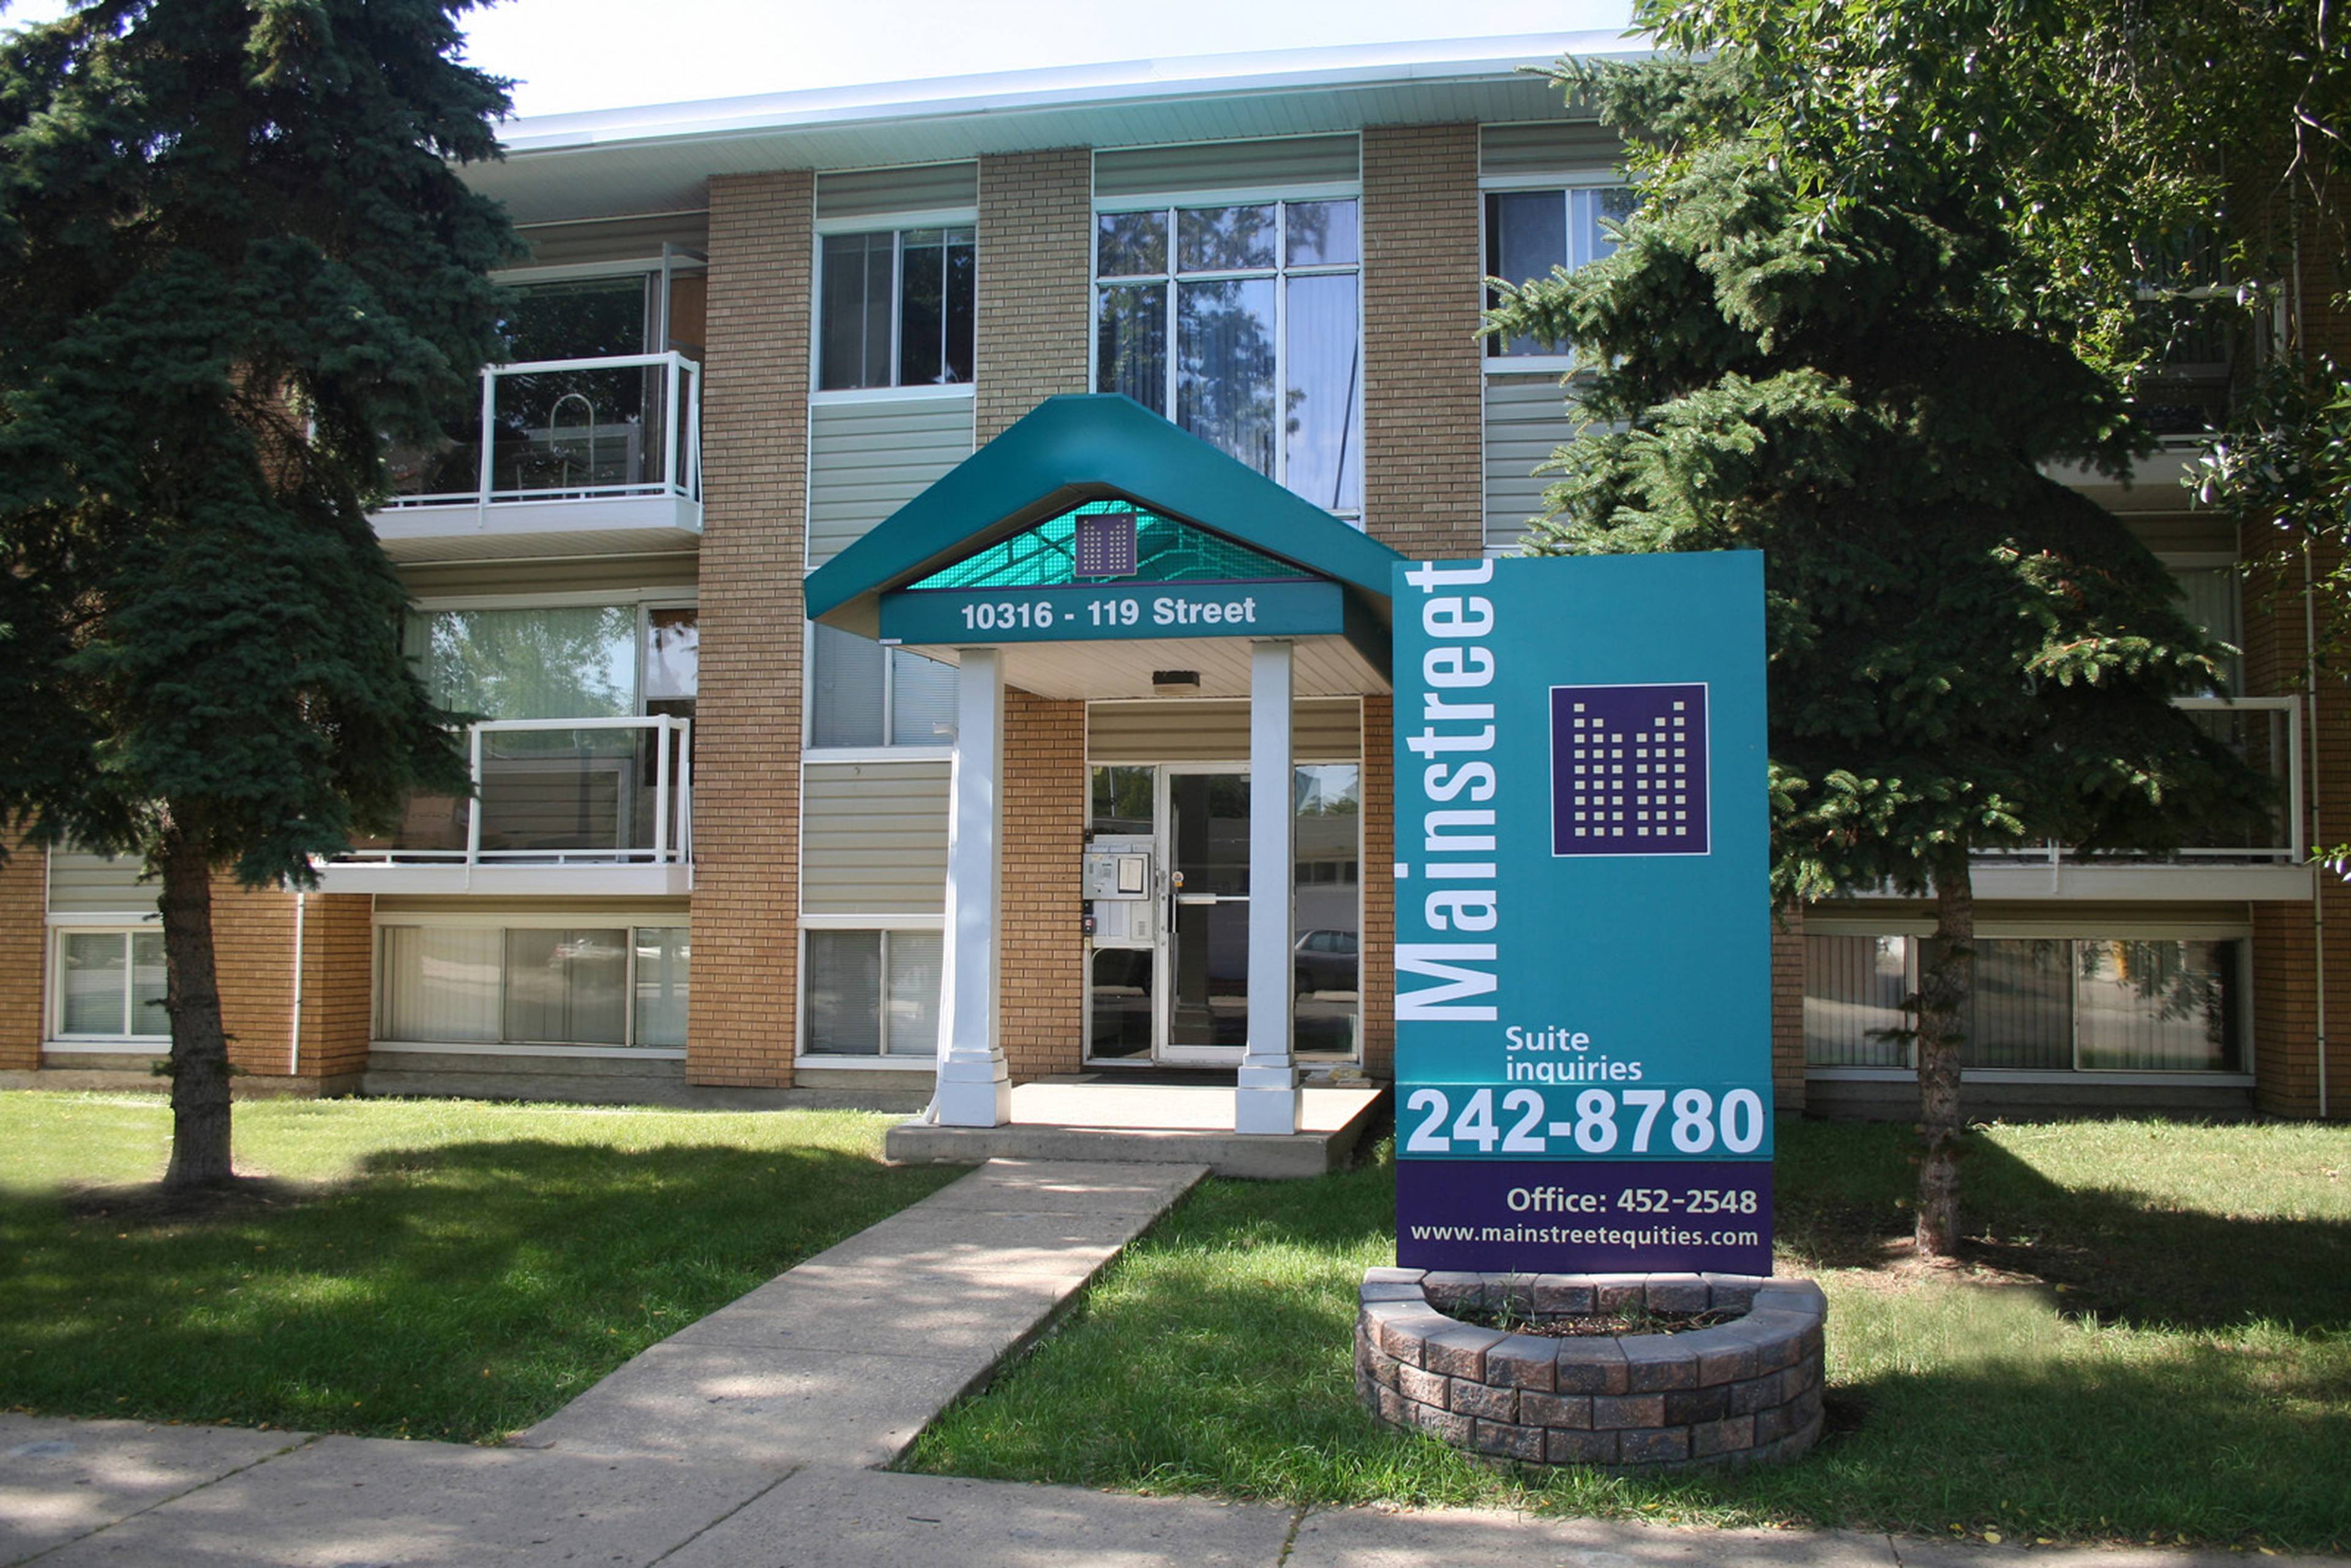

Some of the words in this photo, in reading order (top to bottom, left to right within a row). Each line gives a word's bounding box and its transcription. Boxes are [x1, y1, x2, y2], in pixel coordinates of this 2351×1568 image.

[961, 601, 1053, 629] 10316
[1087, 599, 1139, 626] 119
[1153, 597, 1256, 625] Street
[1394, 558, 1497, 1021] Mainstreet
[1505, 1026, 1590, 1051] Suite
[1506, 1055, 1643, 1082] inquiries
[1406, 1088, 1764, 1153] 242-8780
[1507, 1187, 1607, 1213] Office:
[1617, 1189, 1758, 1214] 452-2548
[1411, 1223, 1758, 1249] www.mainstreetequities.com
